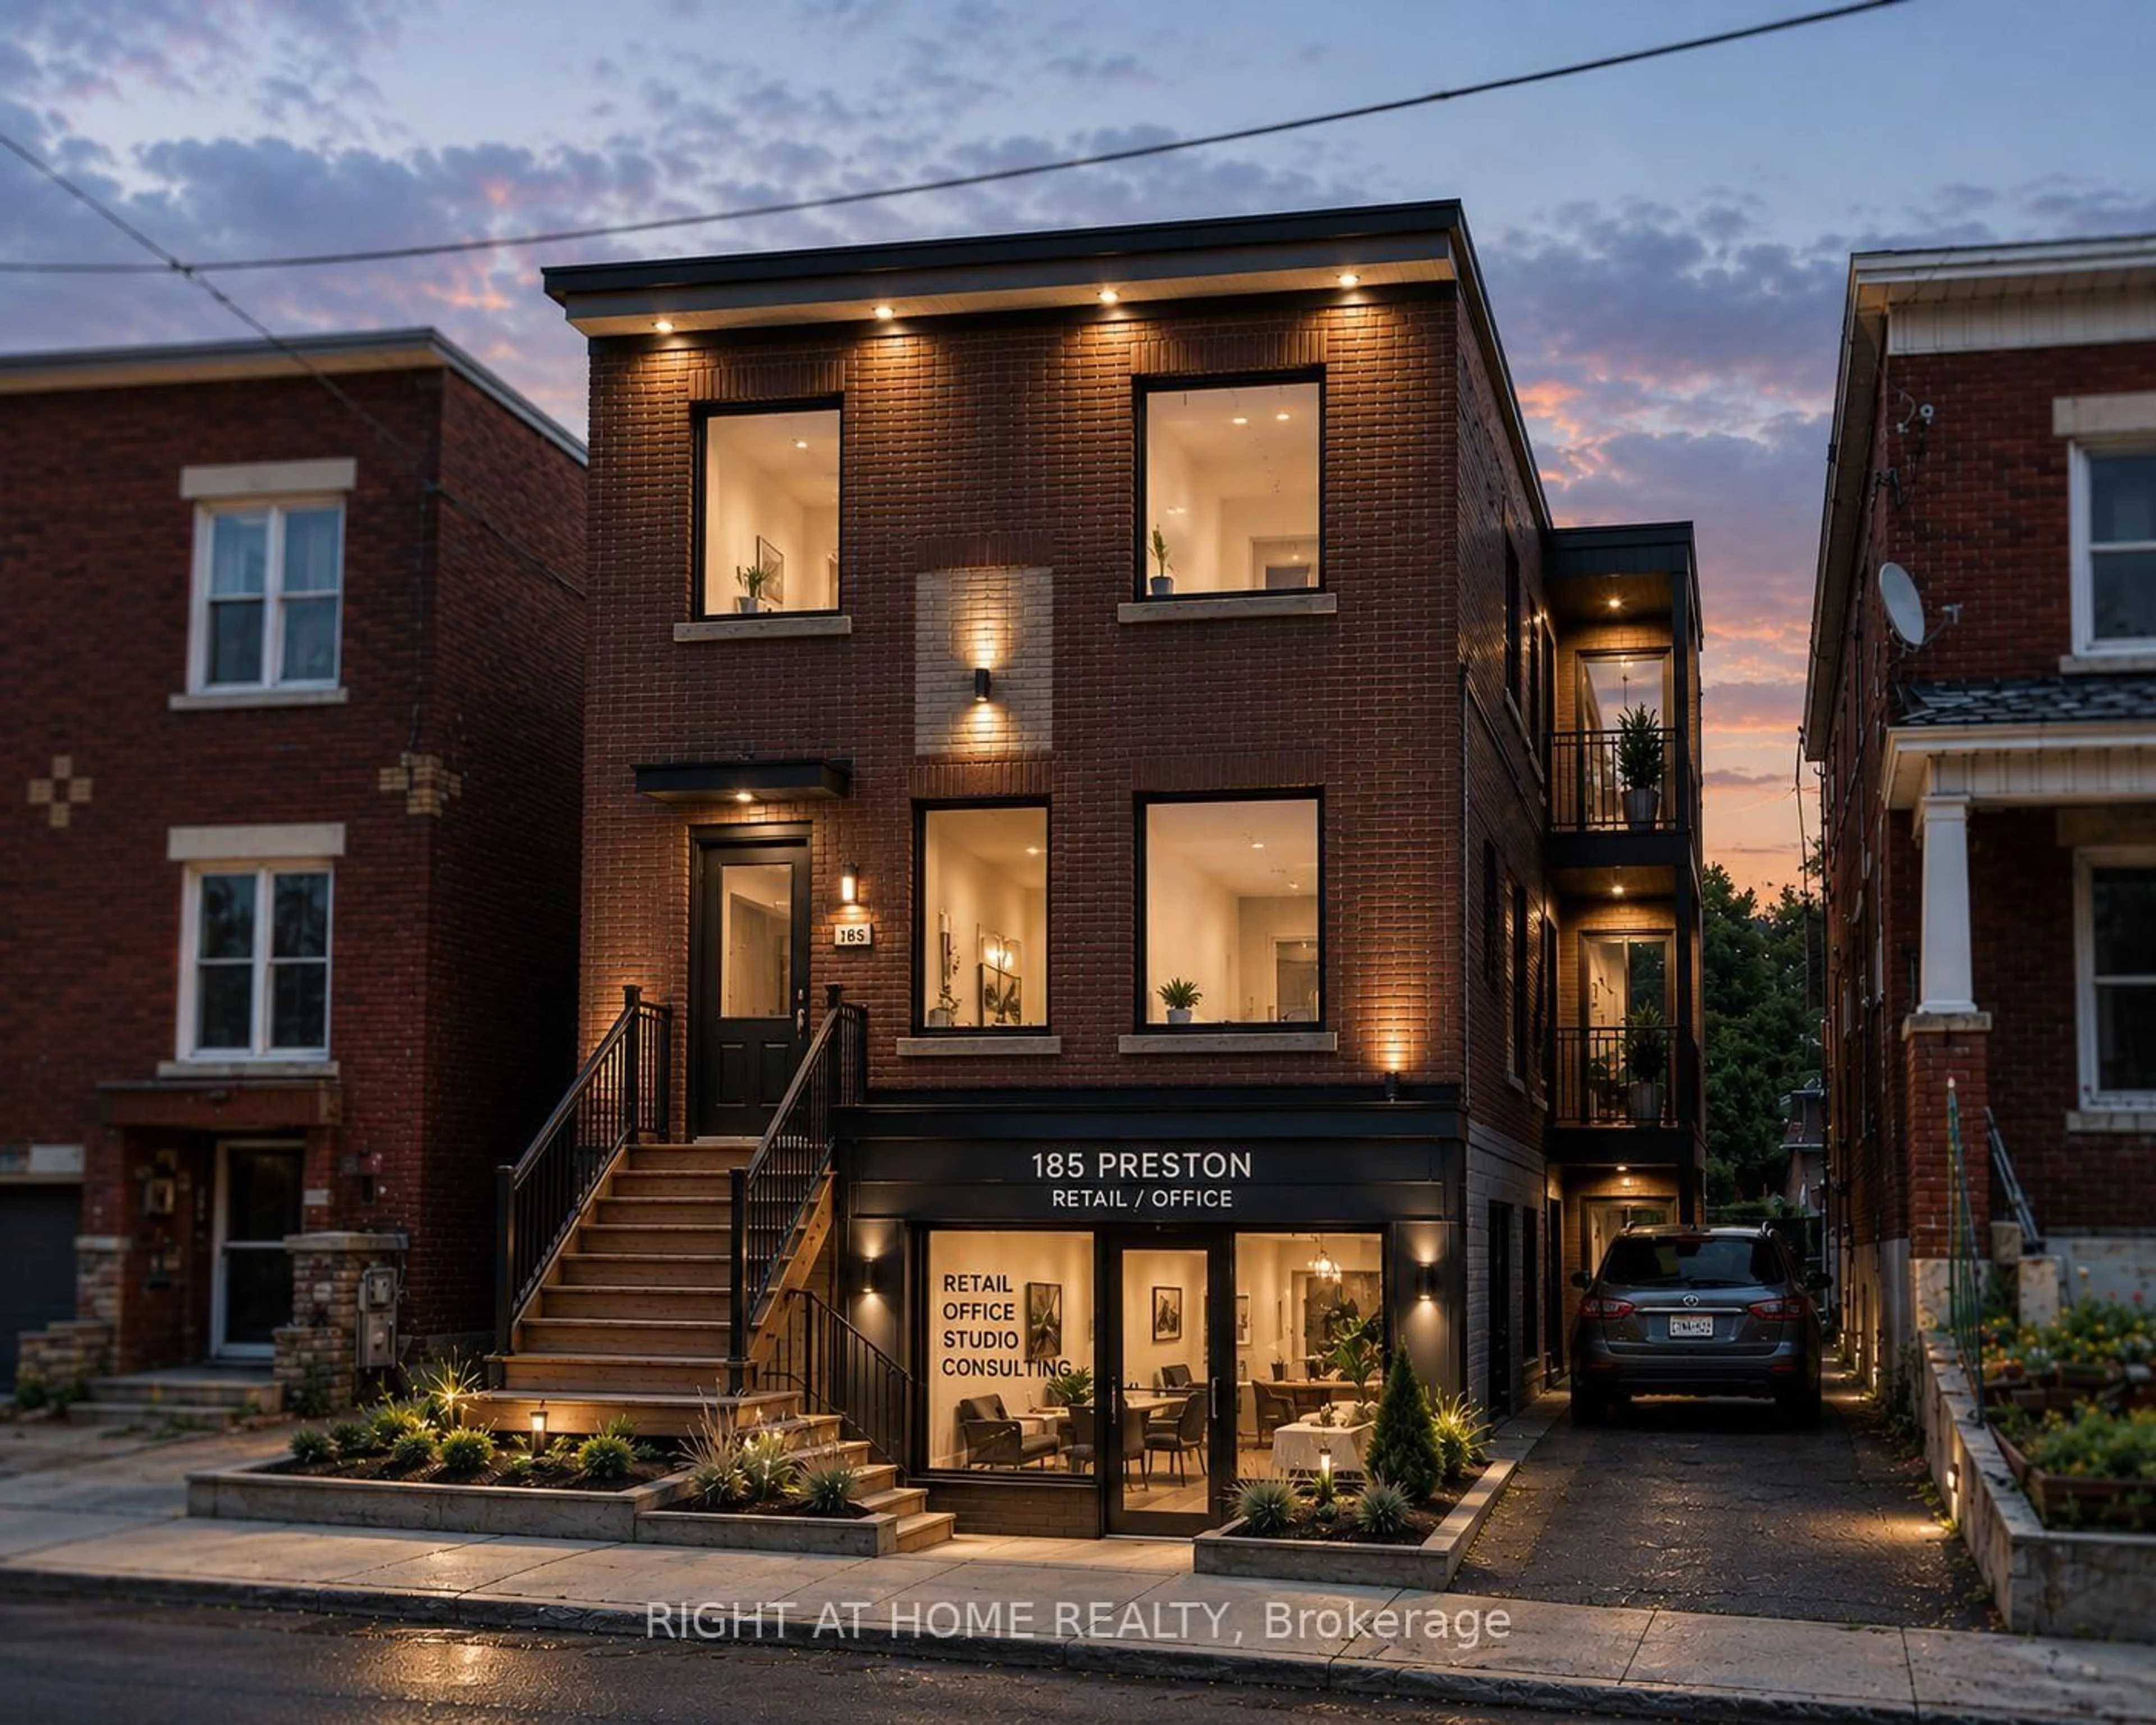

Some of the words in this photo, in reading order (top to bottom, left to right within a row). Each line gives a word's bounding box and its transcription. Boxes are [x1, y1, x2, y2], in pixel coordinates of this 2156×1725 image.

[1032, 1152, 1085, 1179] 185
[1098, 1152, 1252, 1179] PRESTON
[1053, 1189, 1127, 1208] RETAIL
[1134, 1189, 1145, 1209] /
[1152, 1189, 1233, 1208] OFFICE
[943, 1274, 1013, 1293] RETAIL
[943, 1302, 1015, 1321] OFFICE
[943, 1330, 1019, 1349] STUDIO
[942, 1358, 1072, 1378] CONSULTING
